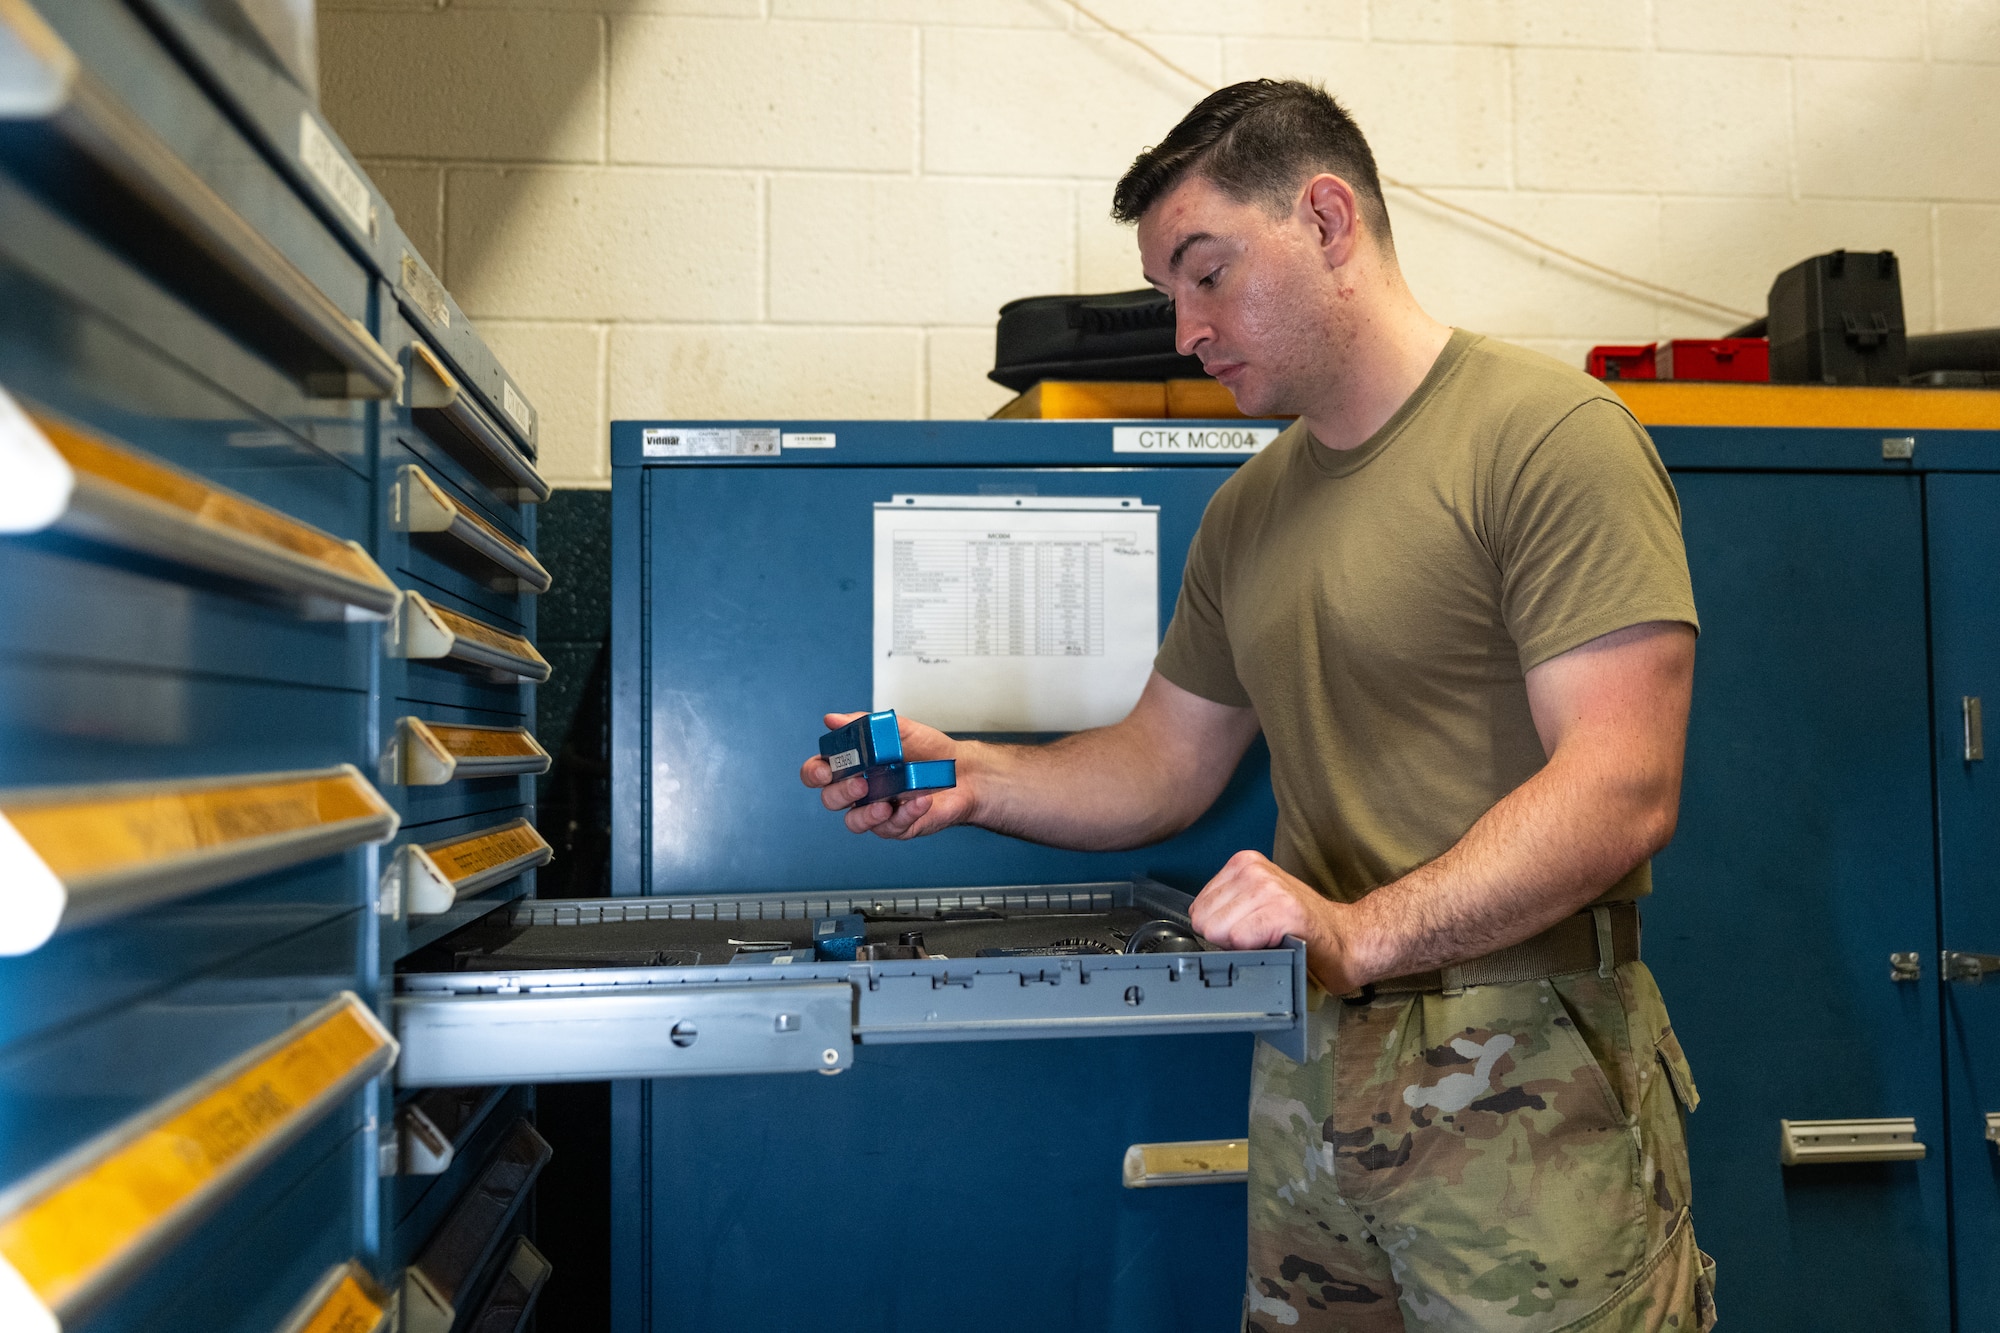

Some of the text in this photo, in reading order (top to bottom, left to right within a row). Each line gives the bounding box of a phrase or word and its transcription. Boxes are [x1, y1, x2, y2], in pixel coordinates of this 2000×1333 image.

[647, 436, 680, 445] Vidmar
[1139, 431, 1256, 449] CTK MC004
